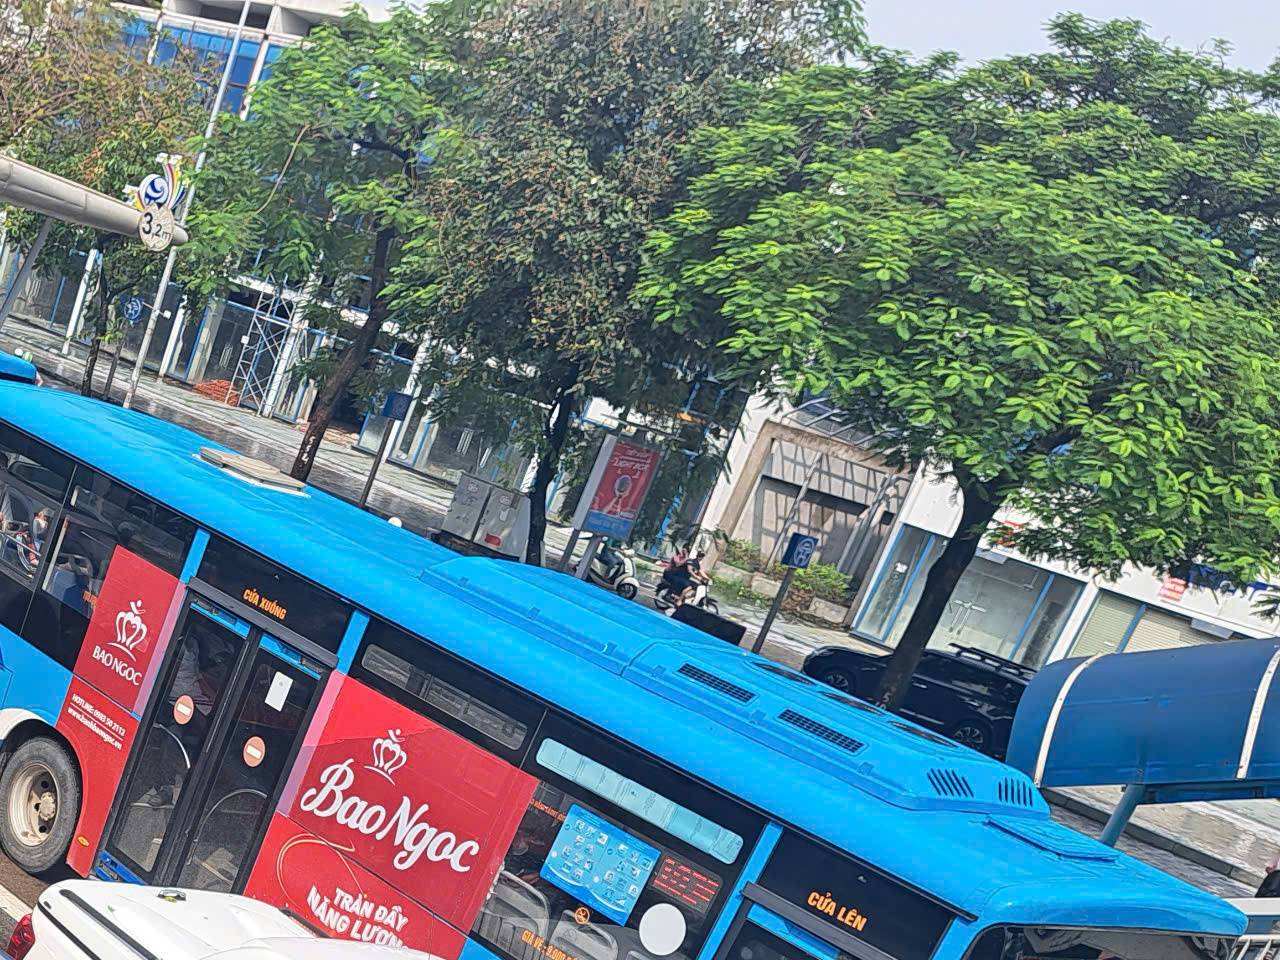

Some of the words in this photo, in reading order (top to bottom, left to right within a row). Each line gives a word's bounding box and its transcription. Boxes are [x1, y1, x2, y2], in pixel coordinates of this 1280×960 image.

[242, 587, 261, 608] CỬA
[259, 597, 287, 620] XUỐNG
[92, 645, 113, 668] BAO
[111, 656, 142, 686] NGOC
[306, 884, 351, 933] NĂNG
[333, 887, 375, 919] TRÀN
[373, 904, 409, 932] ĐẦY
[807, 891, 837, 917] CỬA
[837, 906, 868, 932] LÊN
[521, 929, 534, 946] GIÁ
[533, 936, 544, 951] VÉ
